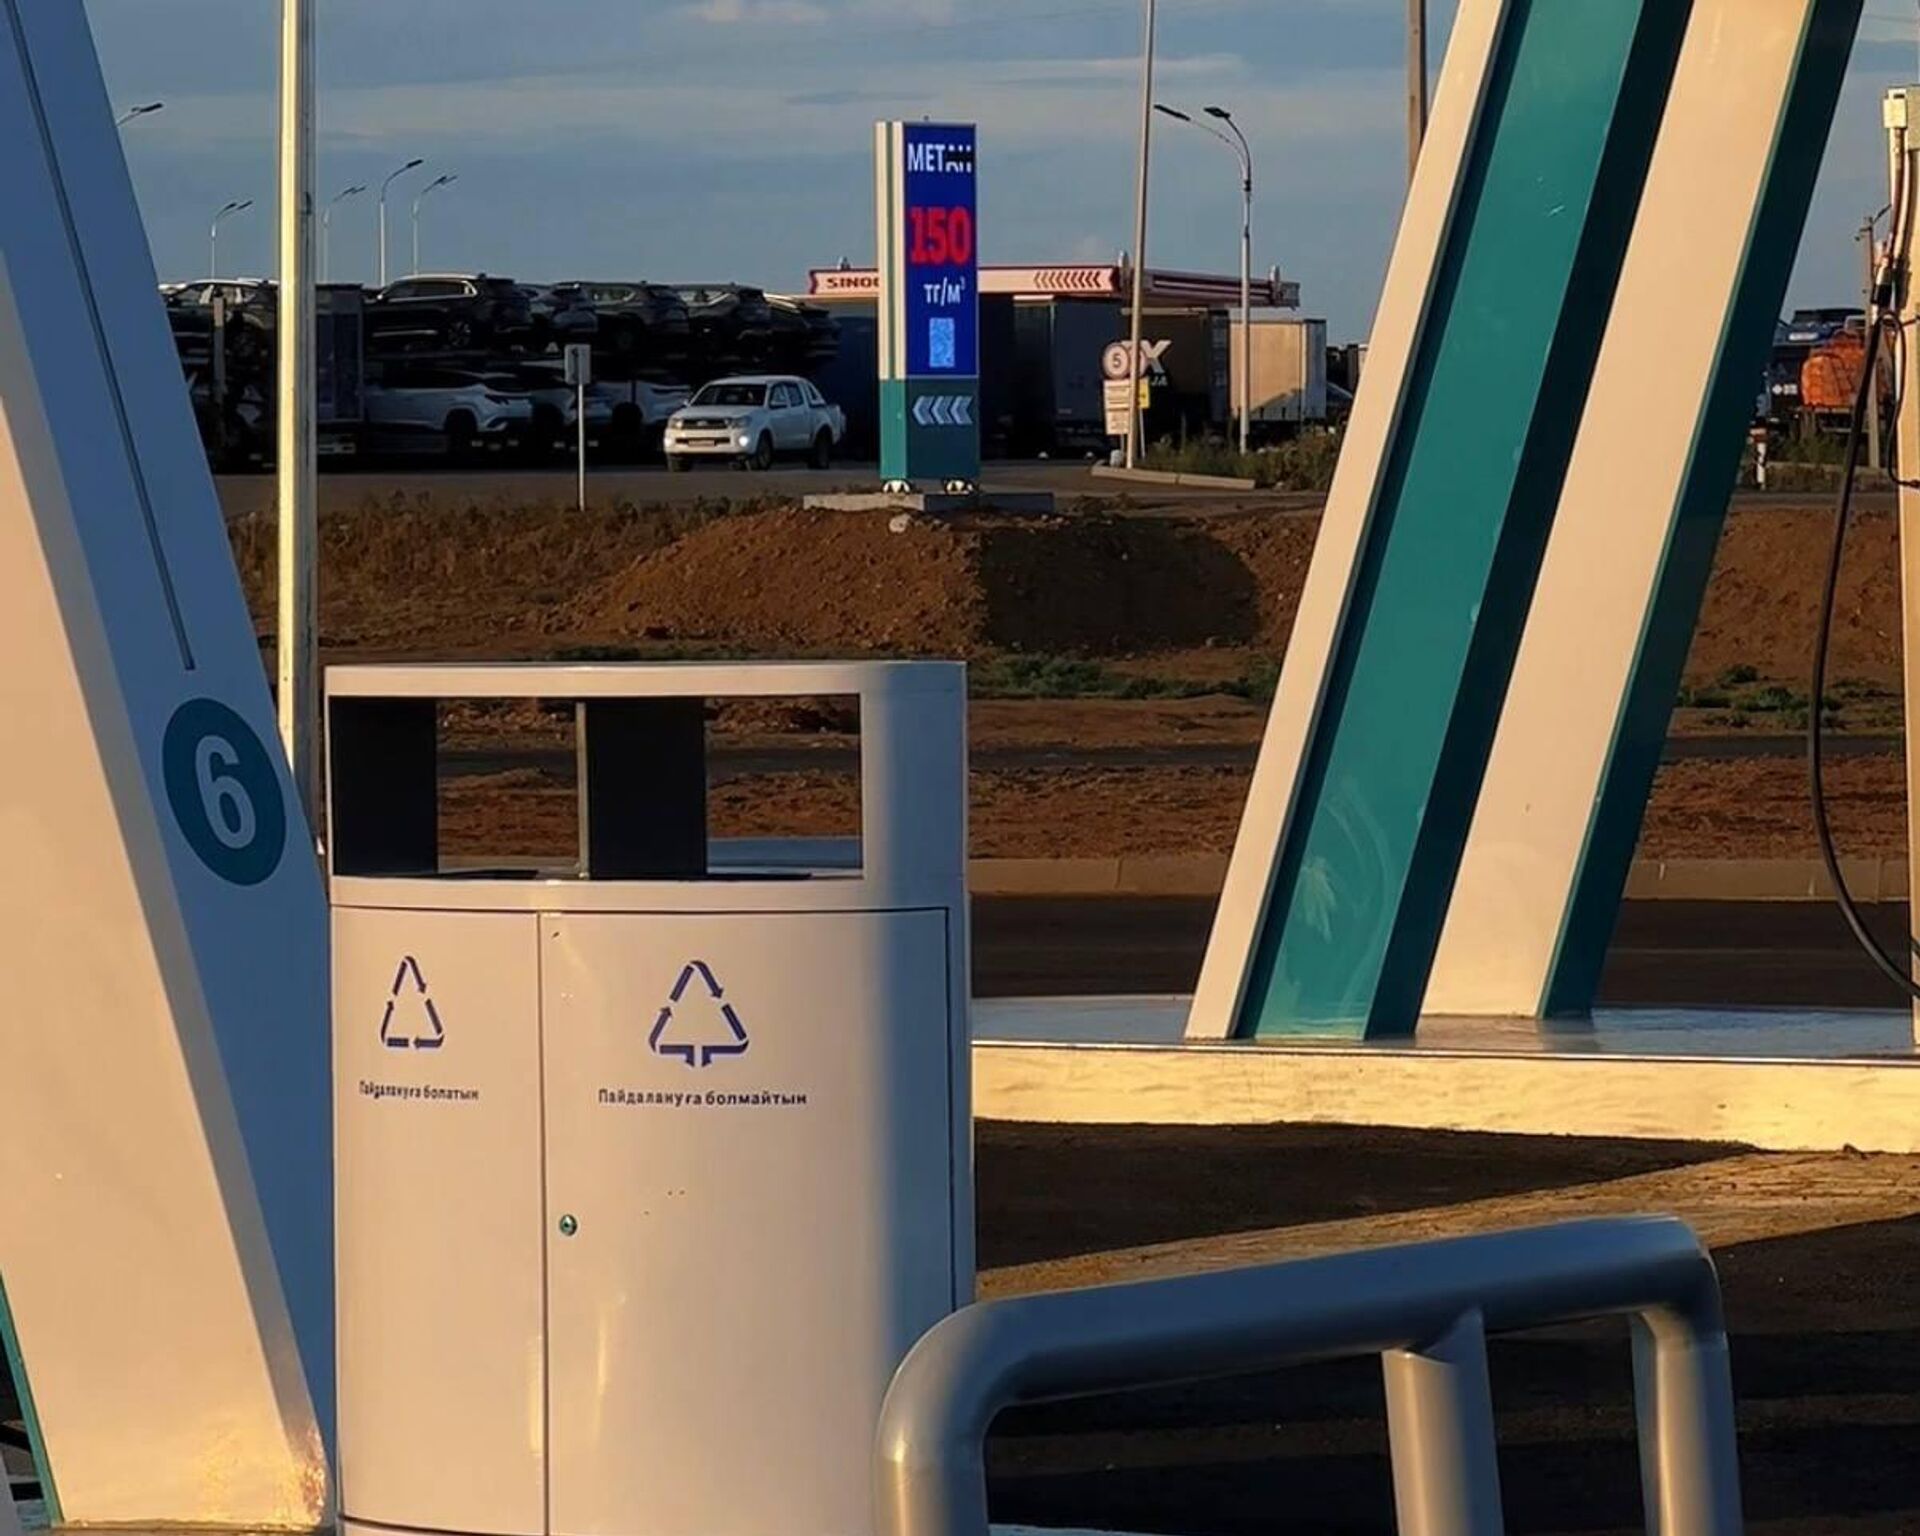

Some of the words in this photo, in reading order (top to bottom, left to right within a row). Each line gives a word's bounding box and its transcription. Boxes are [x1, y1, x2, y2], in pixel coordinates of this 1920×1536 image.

[911, 206, 972, 265] 150
[195, 735, 256, 849] 6
[705, 1089, 807, 1105] болмайтын
